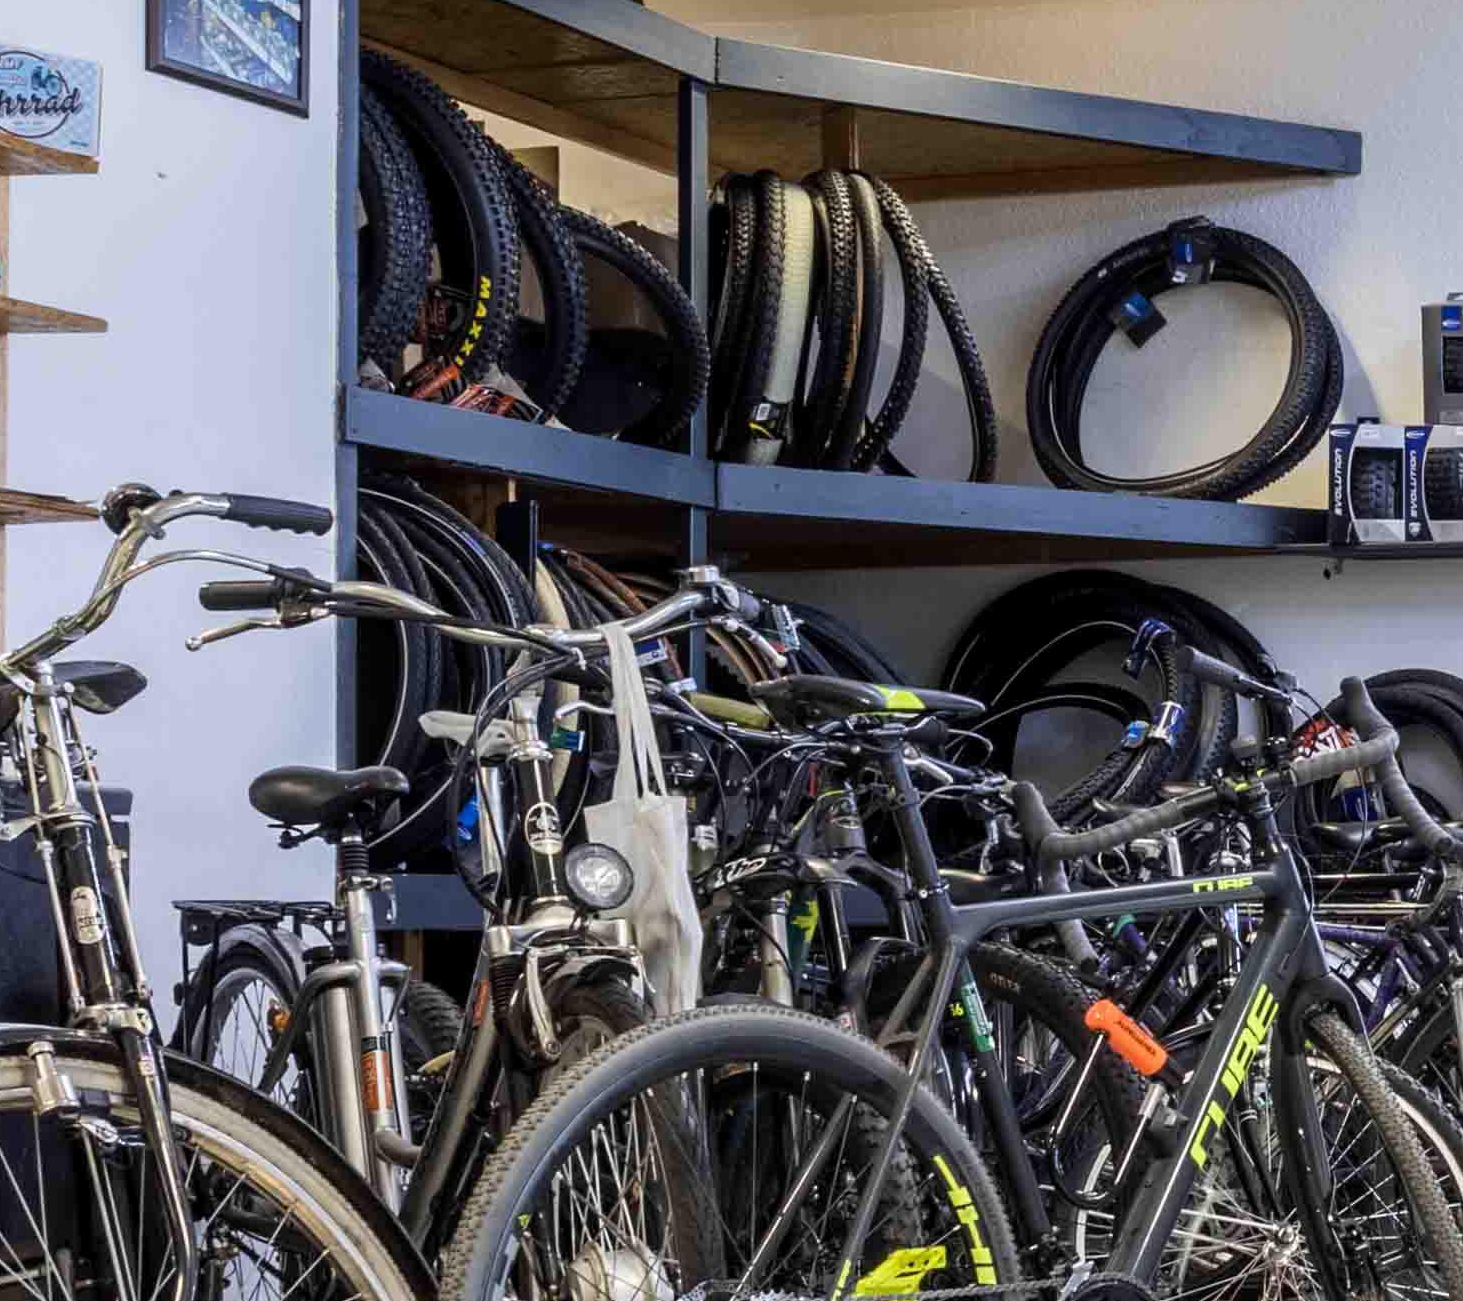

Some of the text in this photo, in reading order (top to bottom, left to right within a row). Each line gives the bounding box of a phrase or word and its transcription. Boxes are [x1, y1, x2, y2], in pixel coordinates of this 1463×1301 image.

[455, 275, 491, 367] MAXXI
[1333, 448, 1343, 516] EVOLUTION
[1409, 449, 1418, 518] EVOLUTION
[1189, 983, 1279, 1169] CUBE
